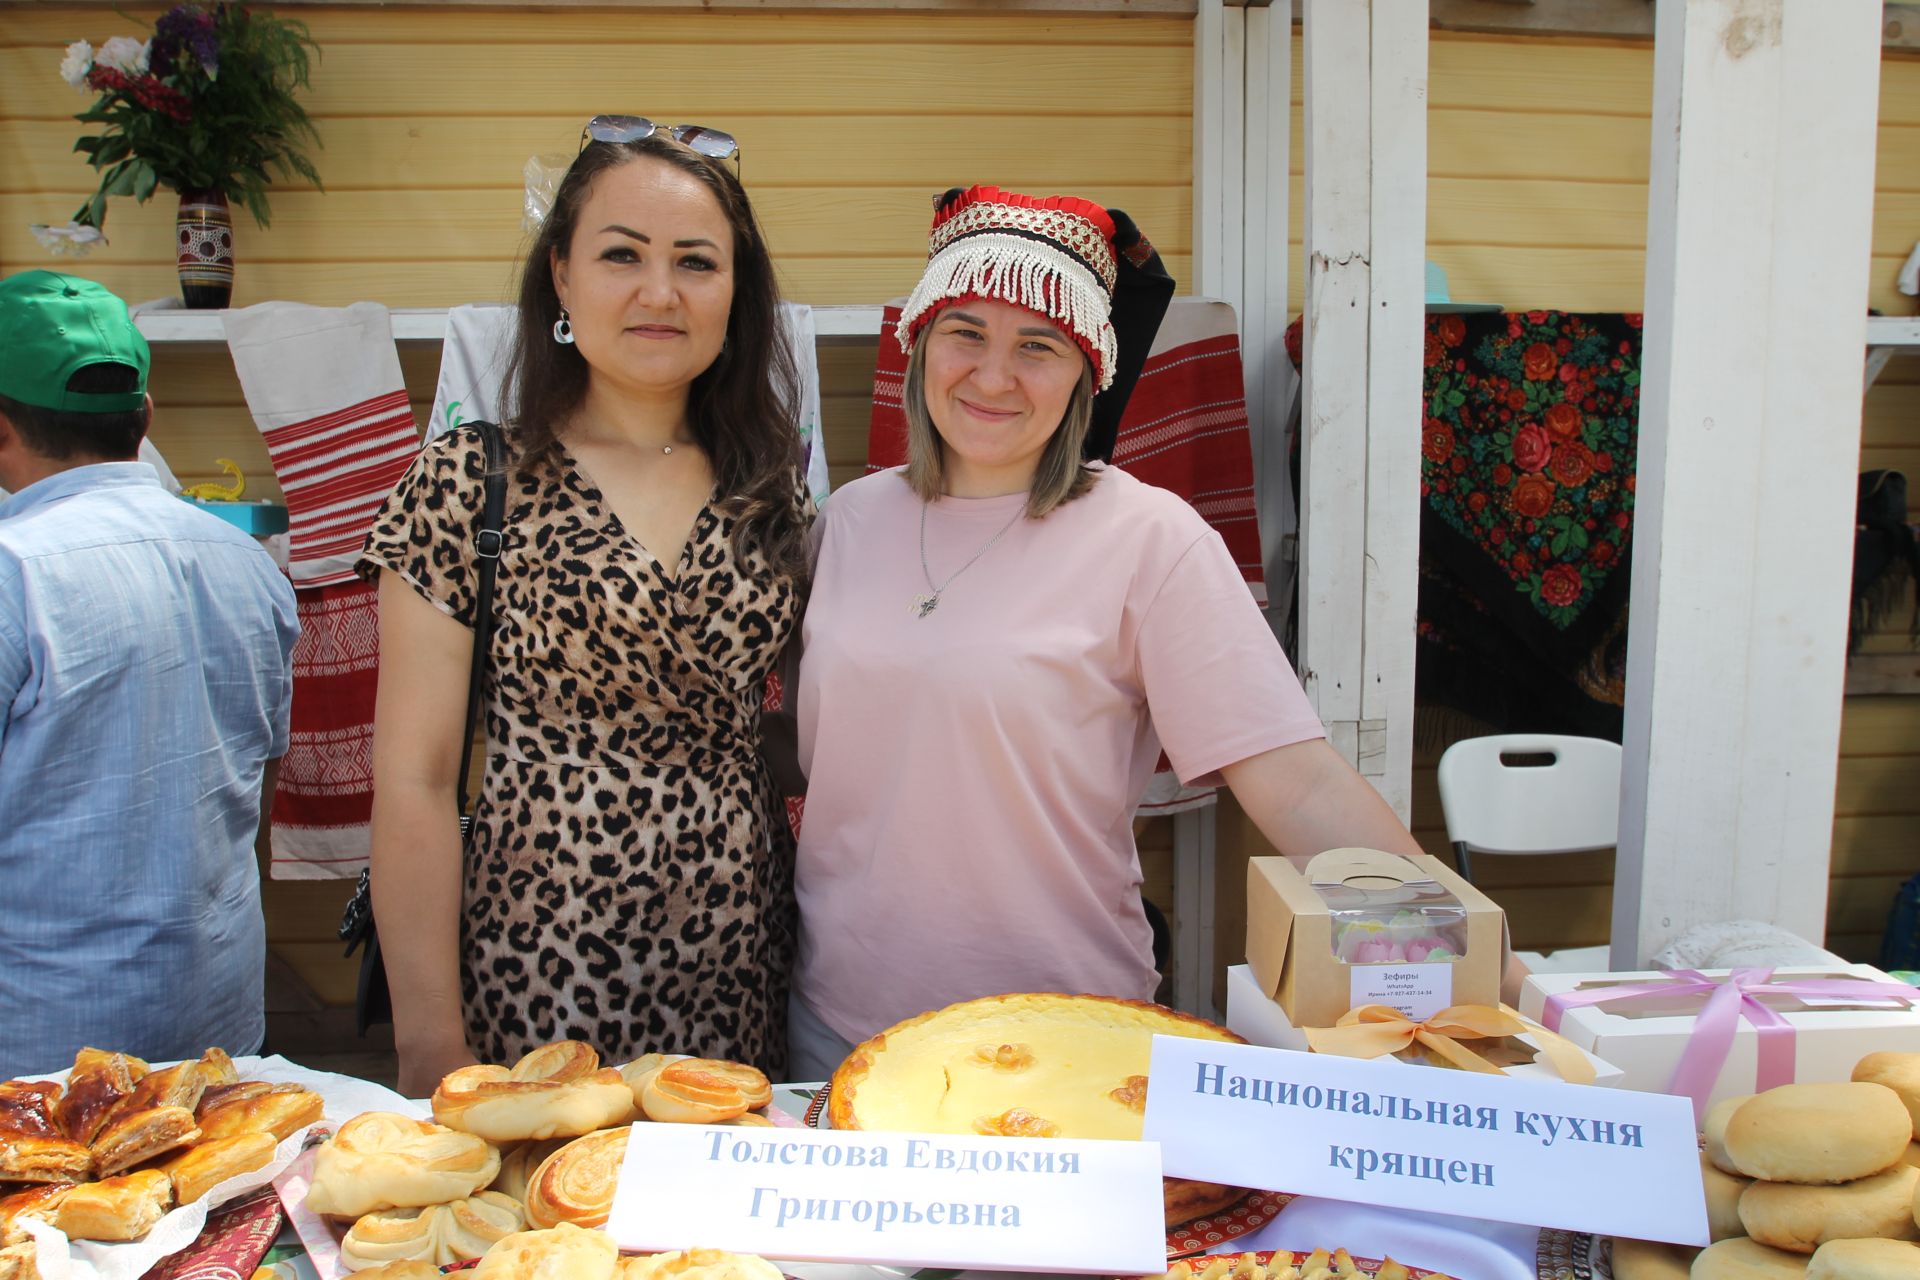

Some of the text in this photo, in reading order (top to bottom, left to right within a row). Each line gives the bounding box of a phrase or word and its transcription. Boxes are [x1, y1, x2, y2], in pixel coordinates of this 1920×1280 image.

[1383, 972, 1419, 981] Зефиры
[1193, 1061, 1644, 1148] Национальная кухня
[704, 1130, 1081, 1175] Толстова Евдокия
[1328, 1143, 1495, 1187] крящен
[747, 1186, 1023, 1232] Григорьевна
